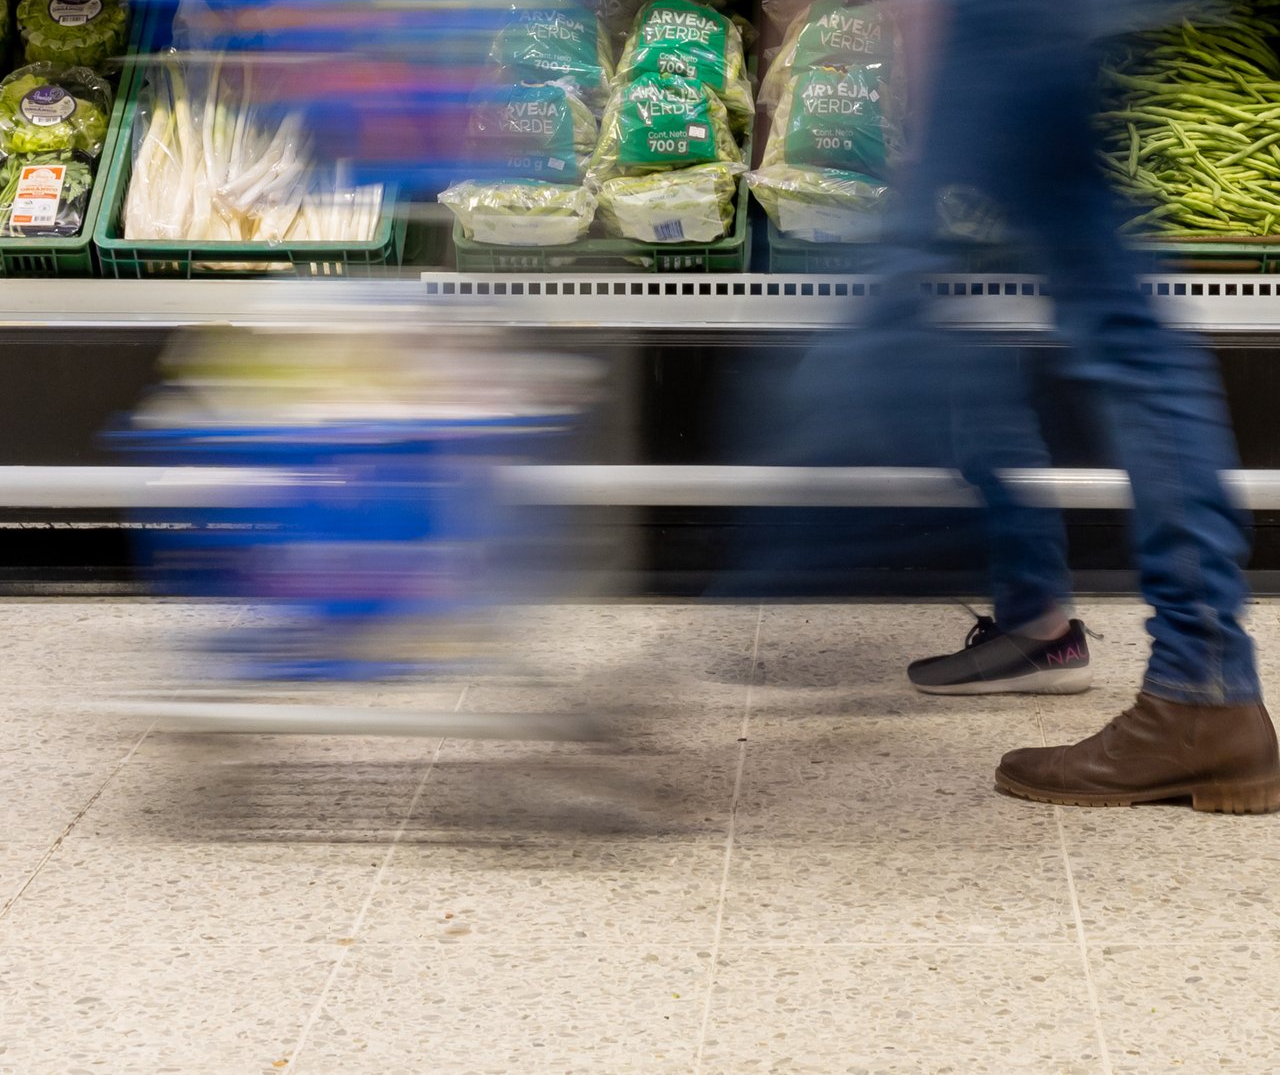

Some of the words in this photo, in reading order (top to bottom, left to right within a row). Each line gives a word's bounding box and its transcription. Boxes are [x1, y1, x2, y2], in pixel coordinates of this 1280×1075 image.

[519, 10, 586, 34] ARVEJA
[649, 10, 719, 31] ARVEJA
[815, 14, 882, 40] ARVEJA
[526, 22, 582, 44] VERDE
[656, 25, 712, 44] VERDE
[818, 29, 876, 55] VERDE
[659, 52, 677, 61] Cont.
[677, 54, 699, 64] Neto
[534, 59, 558, 70] 700
[561, 63, 571, 74] g
[659, 61, 684, 73] 700
[686, 65, 696, 77] g
[630, 86, 702, 102] ARVEJA
[800, 82, 867, 101] ARVEJA
[636, 101, 696, 116] VERDE
[803, 99, 865, 117] VERDE
[648, 130, 668, 140] Cont.
[668, 129, 688, 139] Neto
[813, 128, 834, 138] Cont.
[834, 128, 854, 138] Neto
[649, 139, 672, 152] 700
[676, 140, 688, 155] g
[815, 137, 839, 150] 700
[843, 138, 853, 151] g
